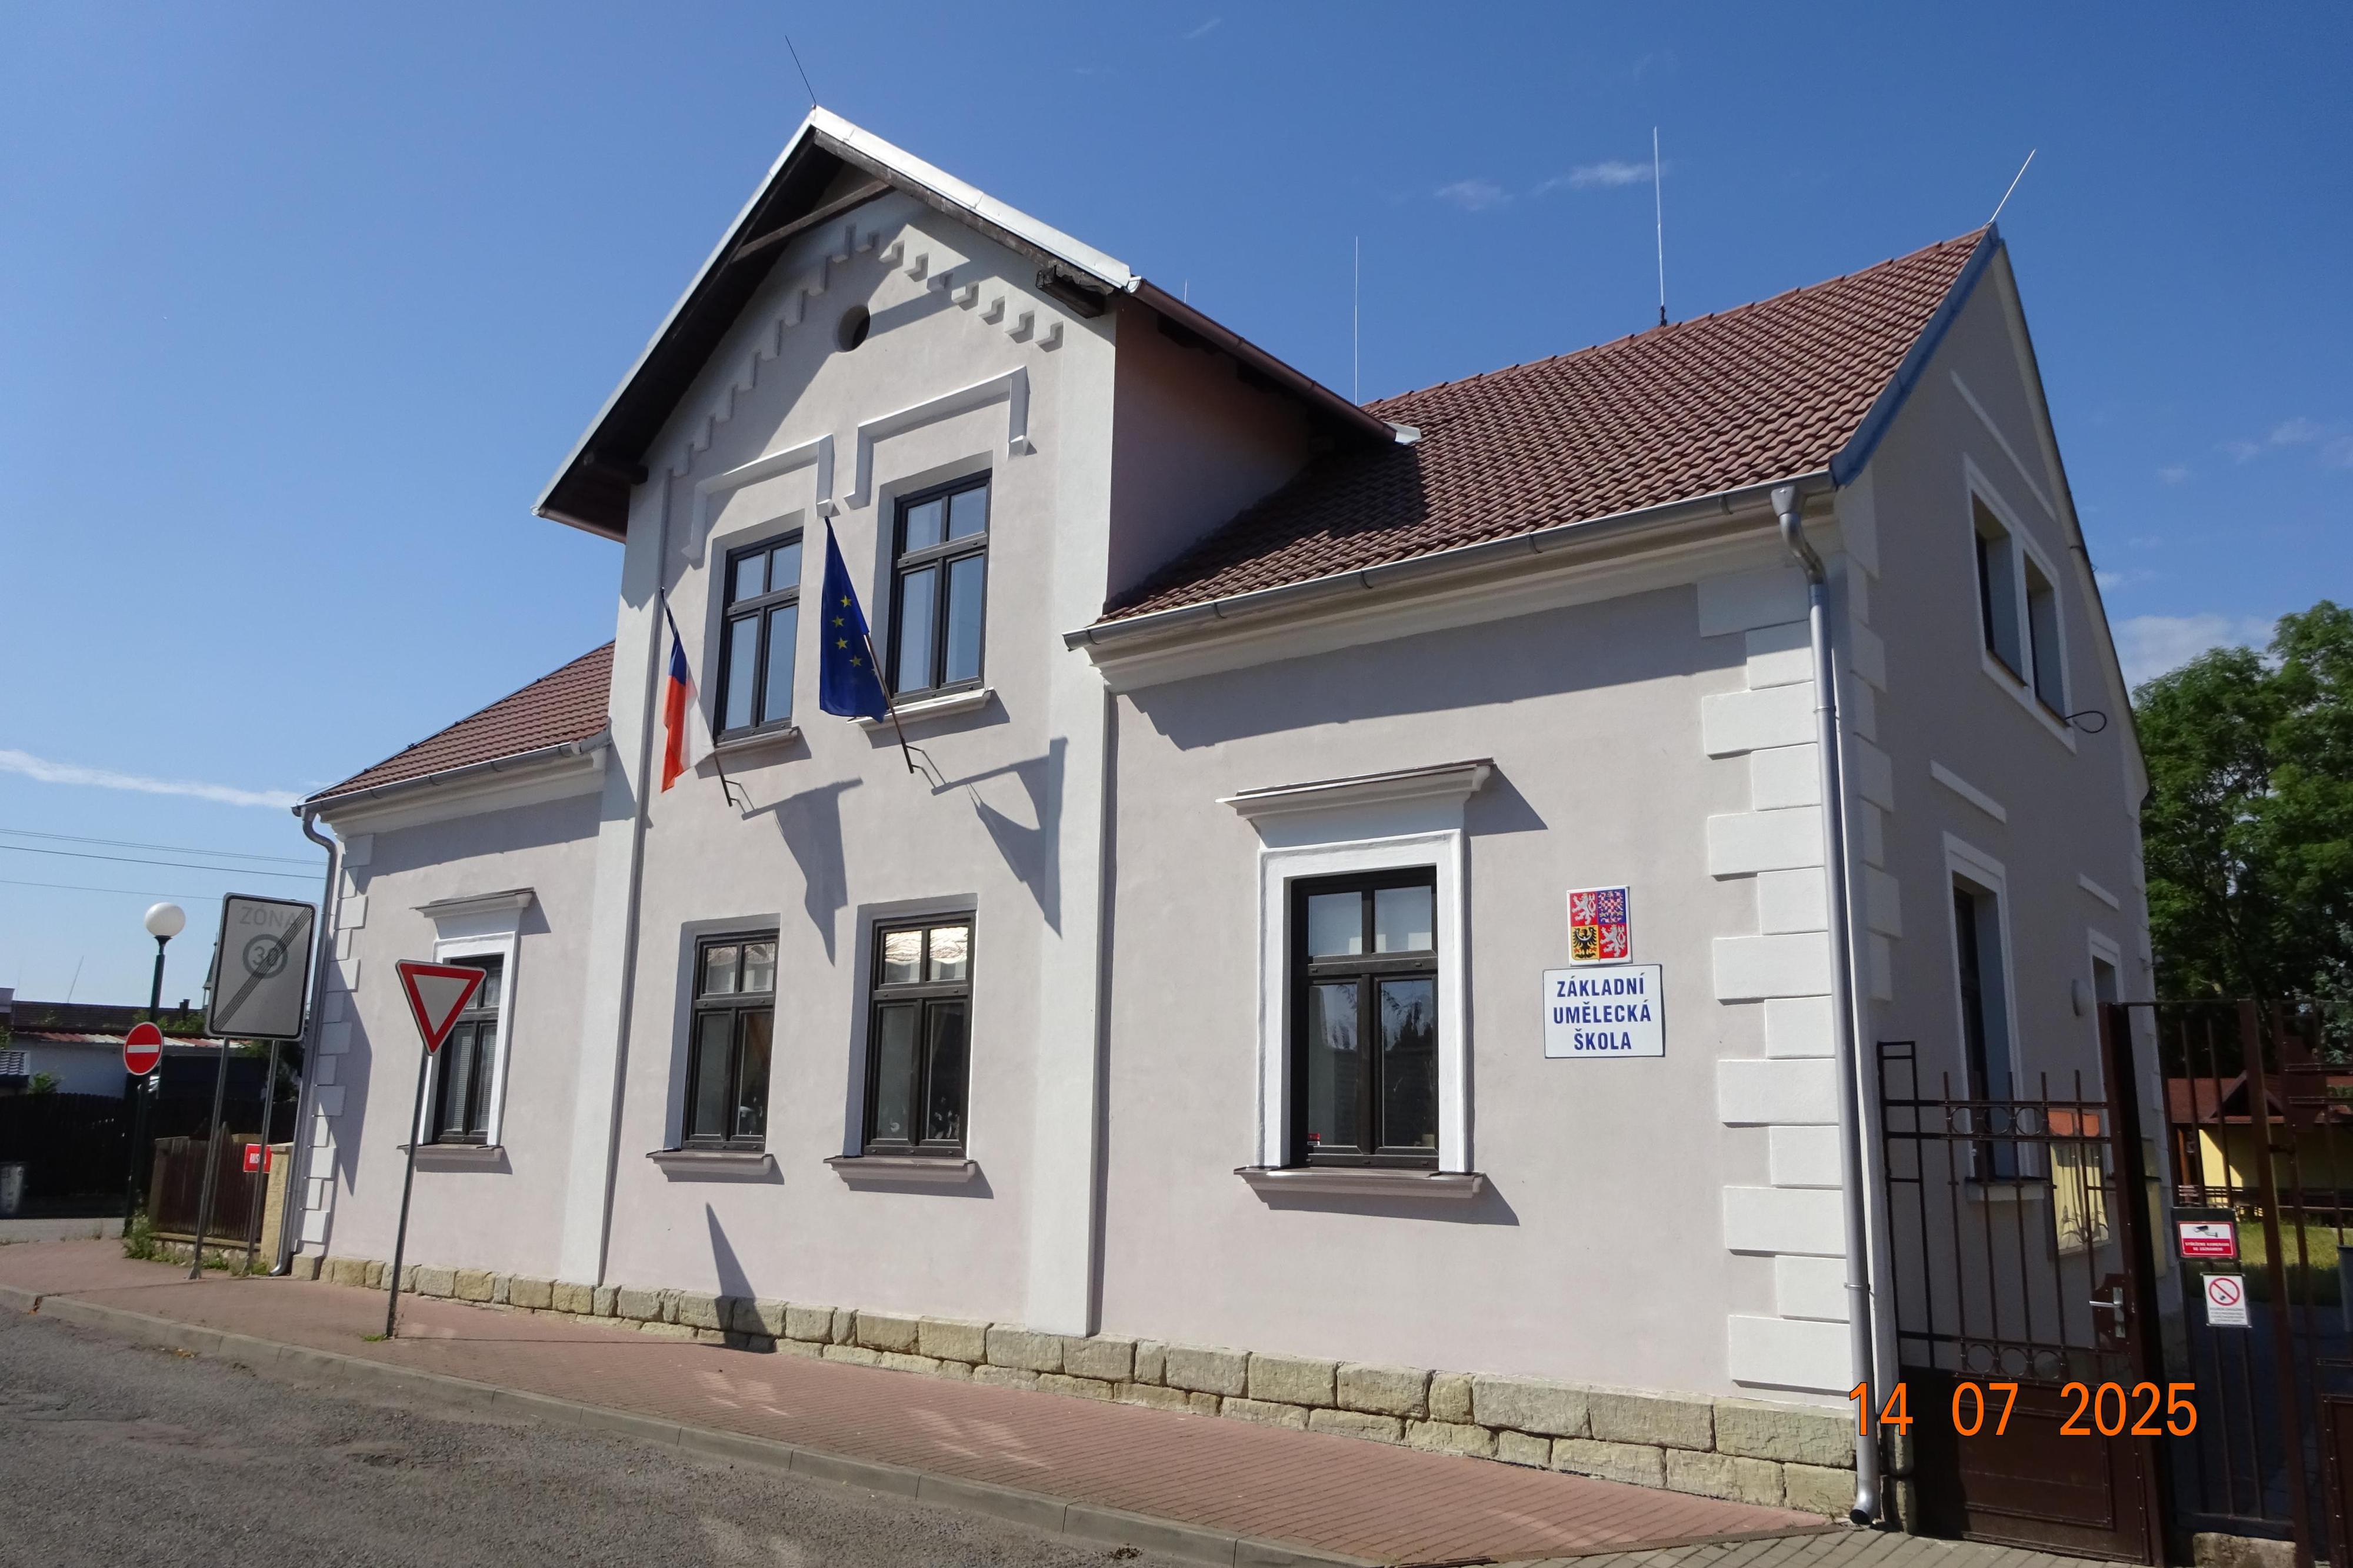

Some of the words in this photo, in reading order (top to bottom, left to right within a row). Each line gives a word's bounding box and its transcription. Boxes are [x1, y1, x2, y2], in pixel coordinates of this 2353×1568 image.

[1557, 972, 1645, 997] ZÁKLADNÍ
[1554, 999, 1651, 1024] UMĚLECKÁ
[1574, 1028, 1632, 1050] ŠKOLA
